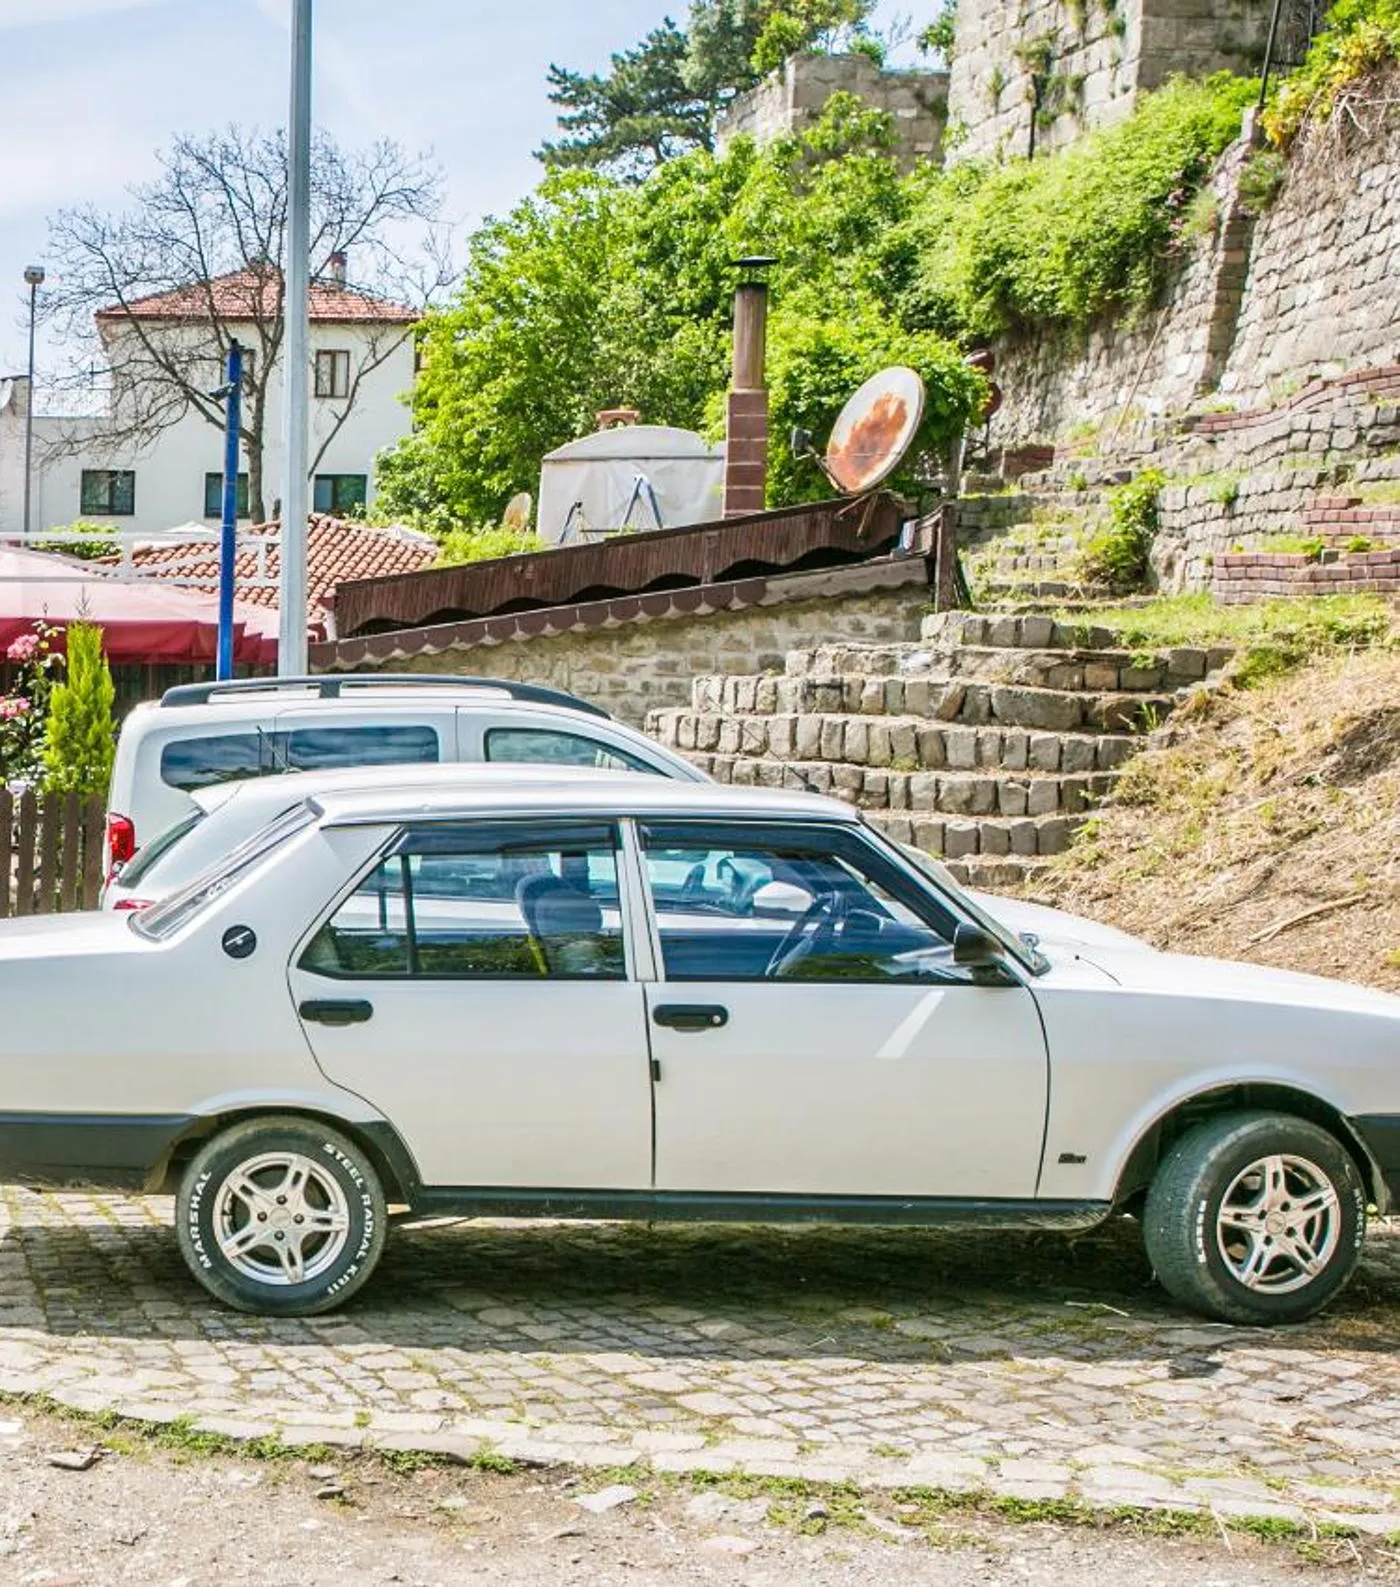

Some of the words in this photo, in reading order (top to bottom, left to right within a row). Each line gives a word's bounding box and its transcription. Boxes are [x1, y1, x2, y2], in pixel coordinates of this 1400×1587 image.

[322, 1143, 367, 1189] STEEL
[189, 1171, 213, 1269] MARSHAL
[355, 1193, 374, 1259] RADIAL
